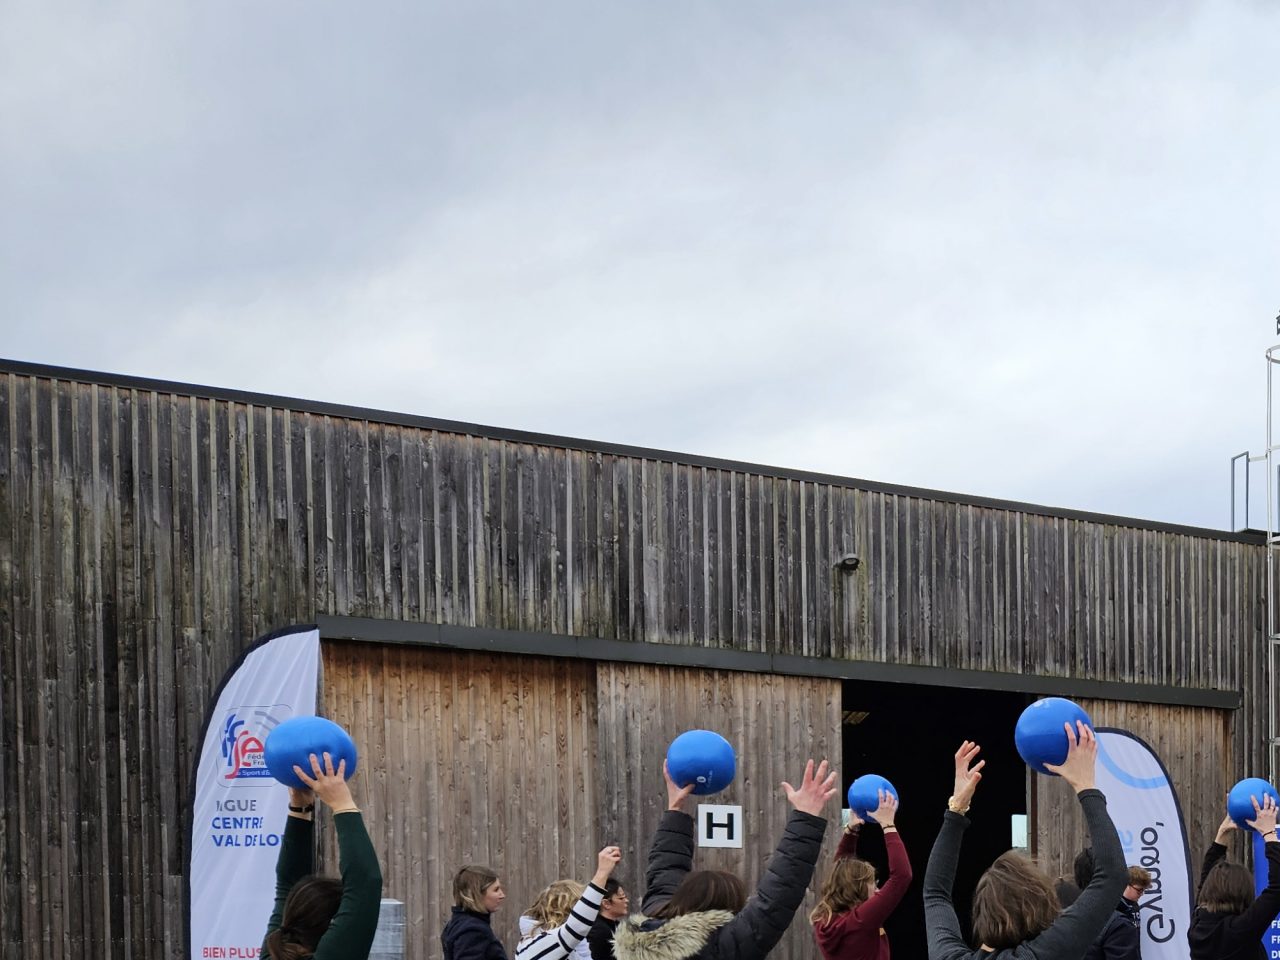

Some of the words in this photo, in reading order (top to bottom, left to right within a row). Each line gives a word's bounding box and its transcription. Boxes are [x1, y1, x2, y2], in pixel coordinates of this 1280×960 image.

[706, 812, 734, 840] H
[212, 834, 241, 847] VAL
[202, 947, 226, 958] BIEN
